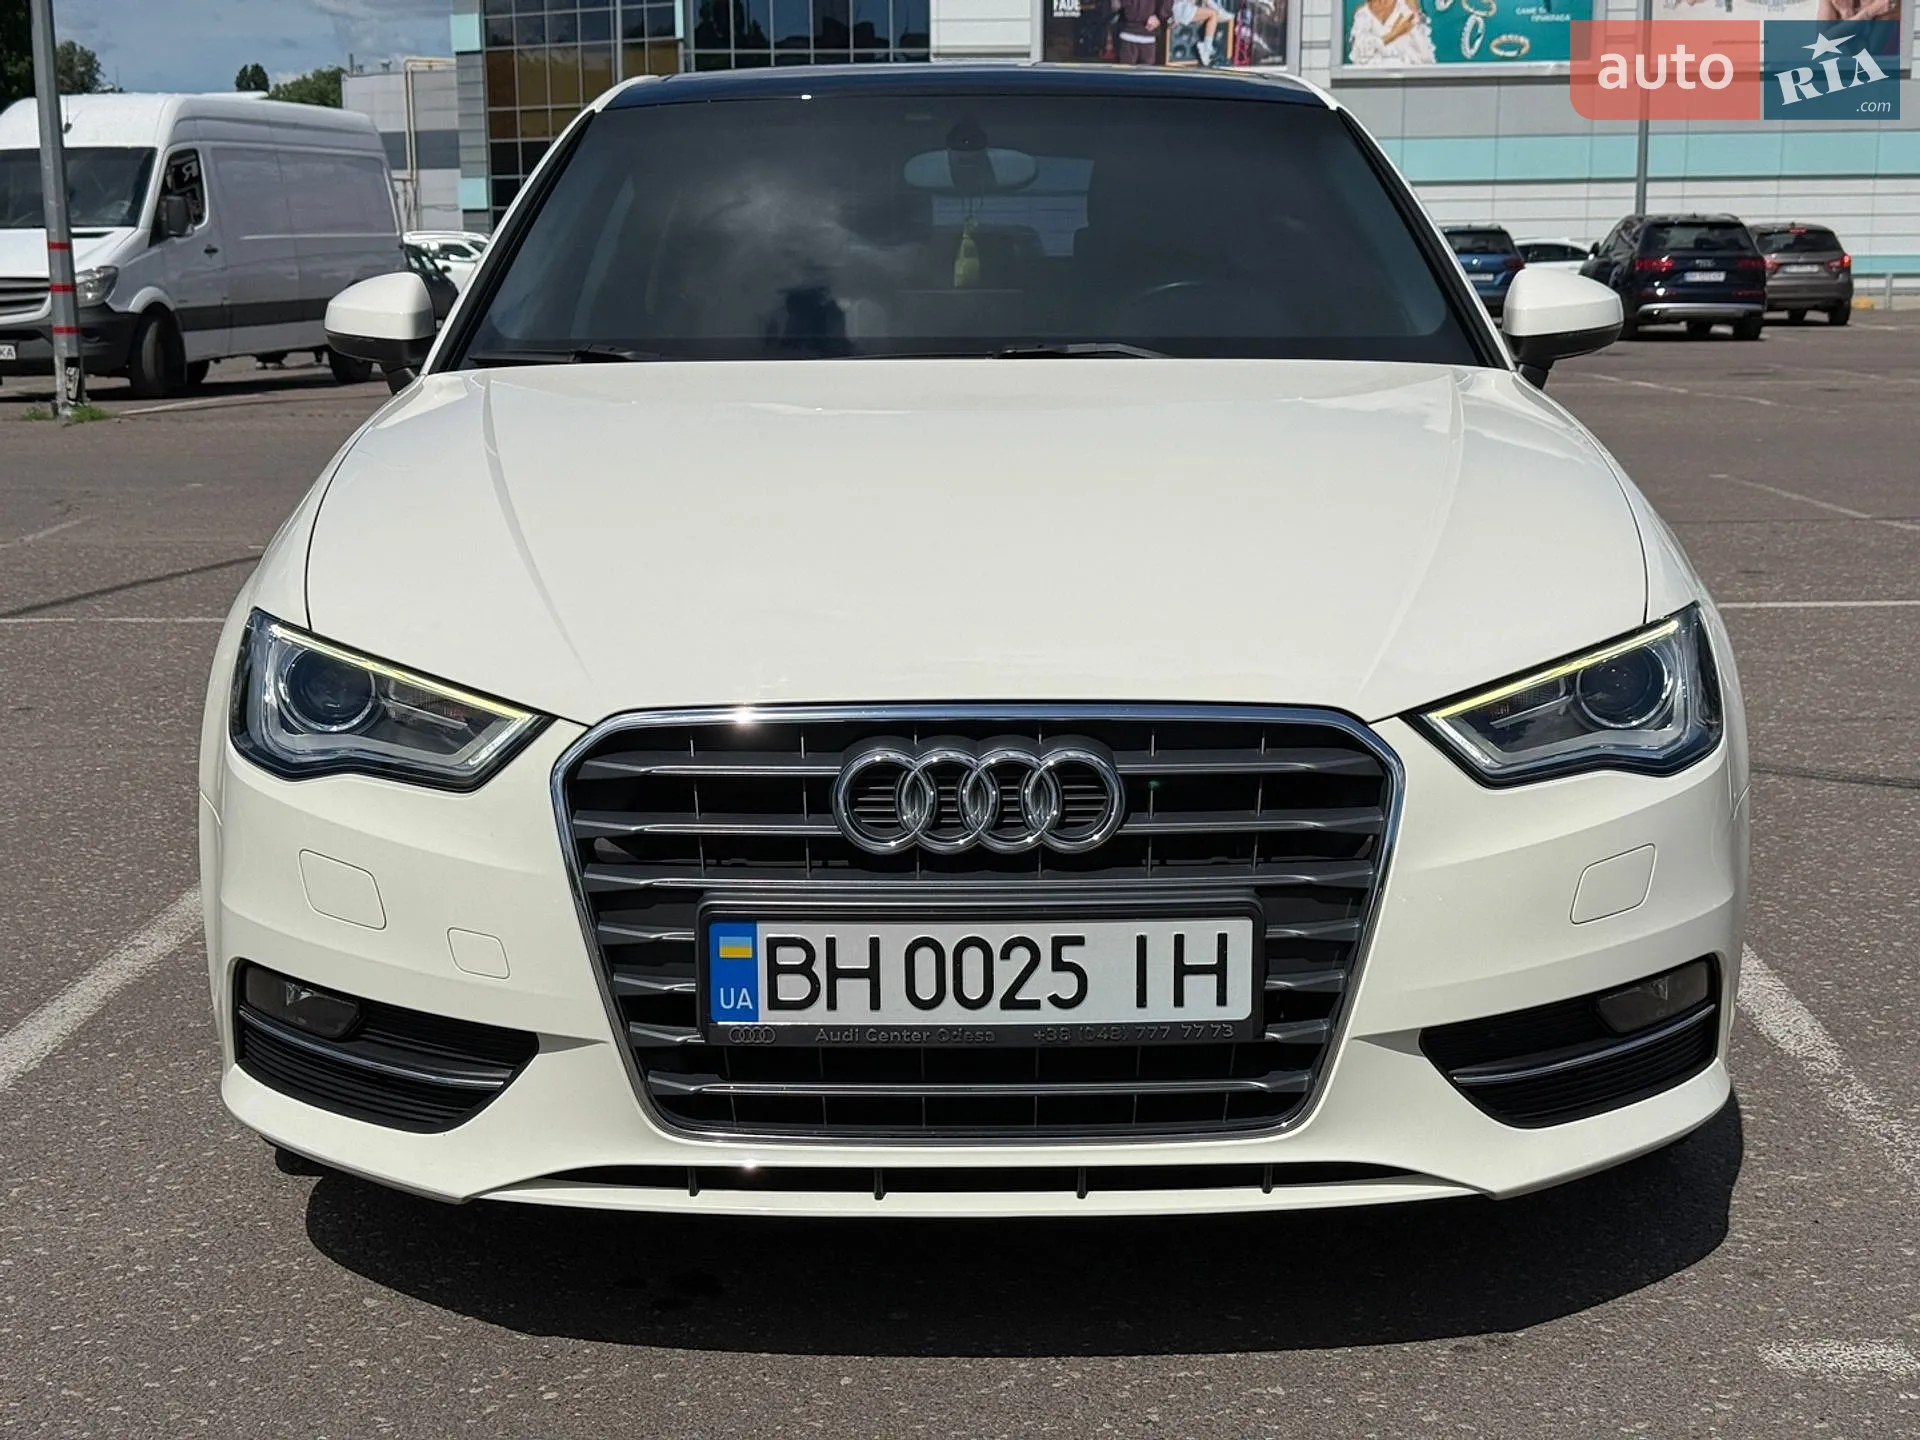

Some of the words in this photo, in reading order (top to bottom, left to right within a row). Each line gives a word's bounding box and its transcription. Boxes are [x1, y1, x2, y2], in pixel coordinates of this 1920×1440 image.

[766, 936, 882, 1011] BH
[904, 935, 1089, 1011] 0025
[1135, 932, 1229, 1009] IH
[719, 987, 754, 1010] UA
[815, 1028, 859, 1043] Audi
[866, 1028, 930, 1043] Center
[1135, 1025, 1172, 1039] 777
